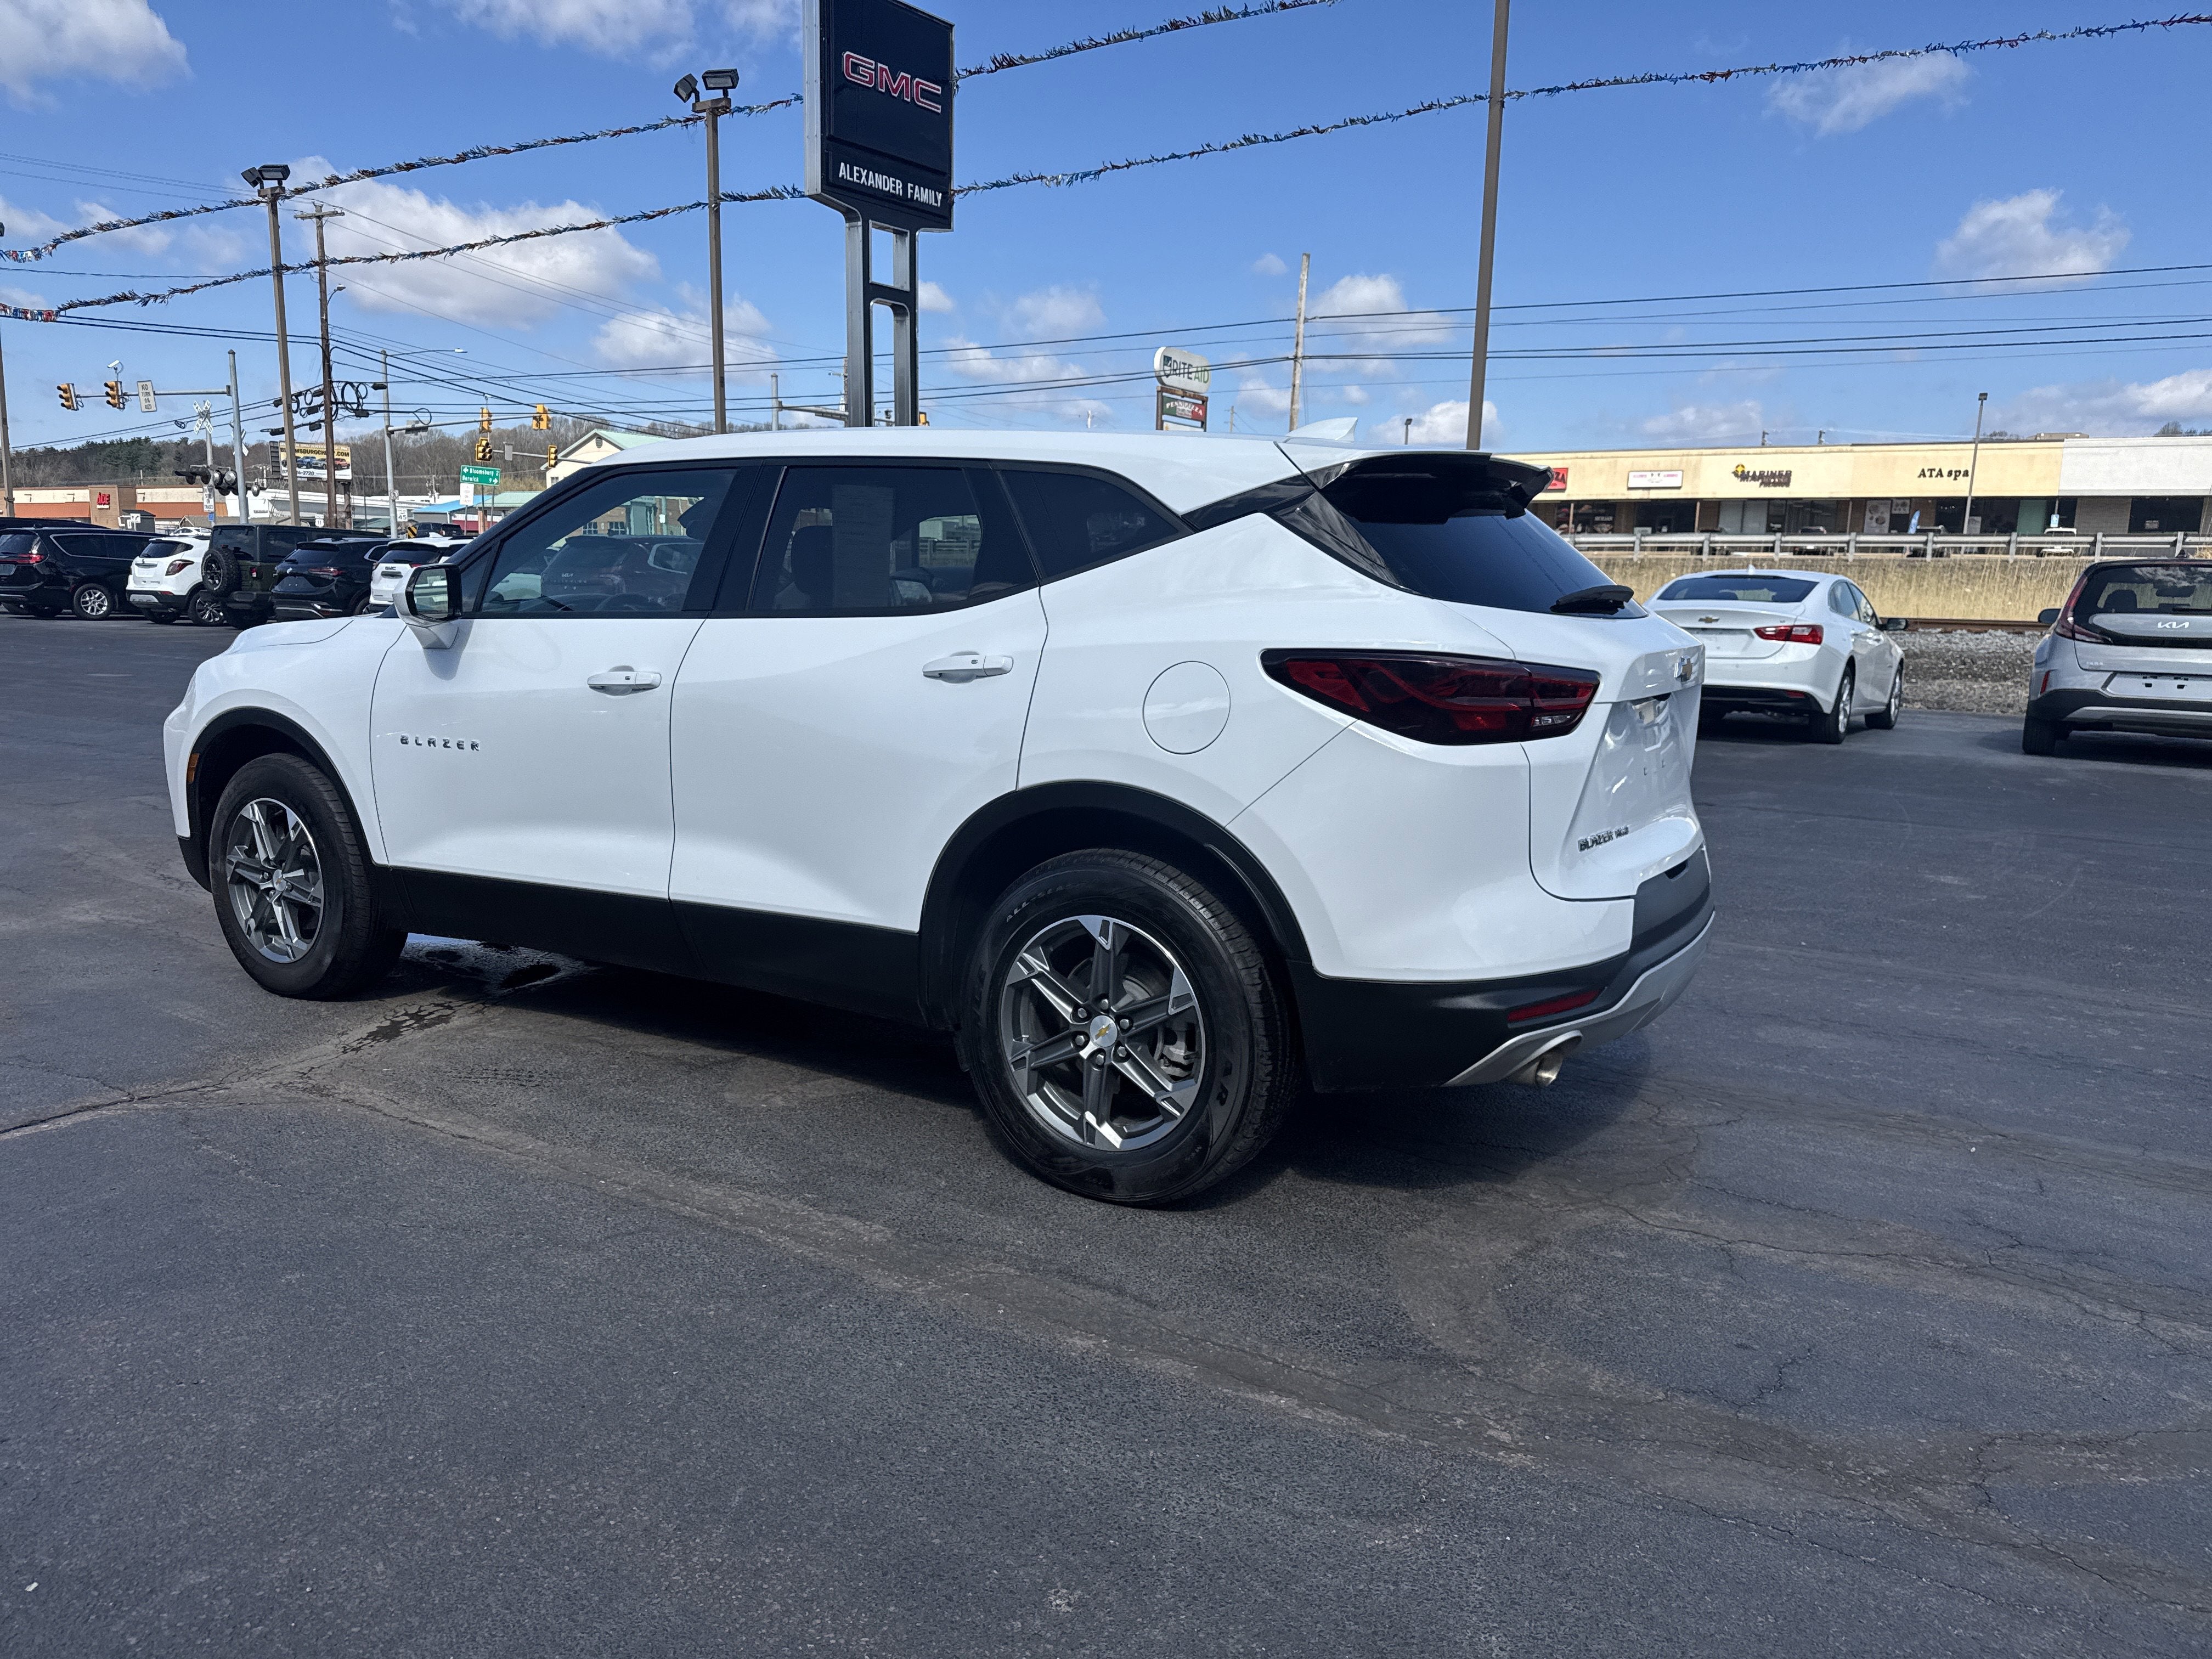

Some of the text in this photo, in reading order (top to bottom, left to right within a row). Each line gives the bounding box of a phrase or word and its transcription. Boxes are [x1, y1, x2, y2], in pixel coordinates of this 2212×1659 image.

[842, 50, 941, 114] GMC
[839, 162, 943, 207] ALEXANDER FAMILY
[1172, 359, 1210, 384] RITE AID
[470, 468, 494, 477] Bloomsburg
[1740, 470, 1792, 482] MARINER
[1917, 468, 1970, 481] ATA spa
[97, 492, 110, 505] ACE
[400, 734, 479, 751] BLAZER
[1578, 830, 1613, 851] BLAZER
